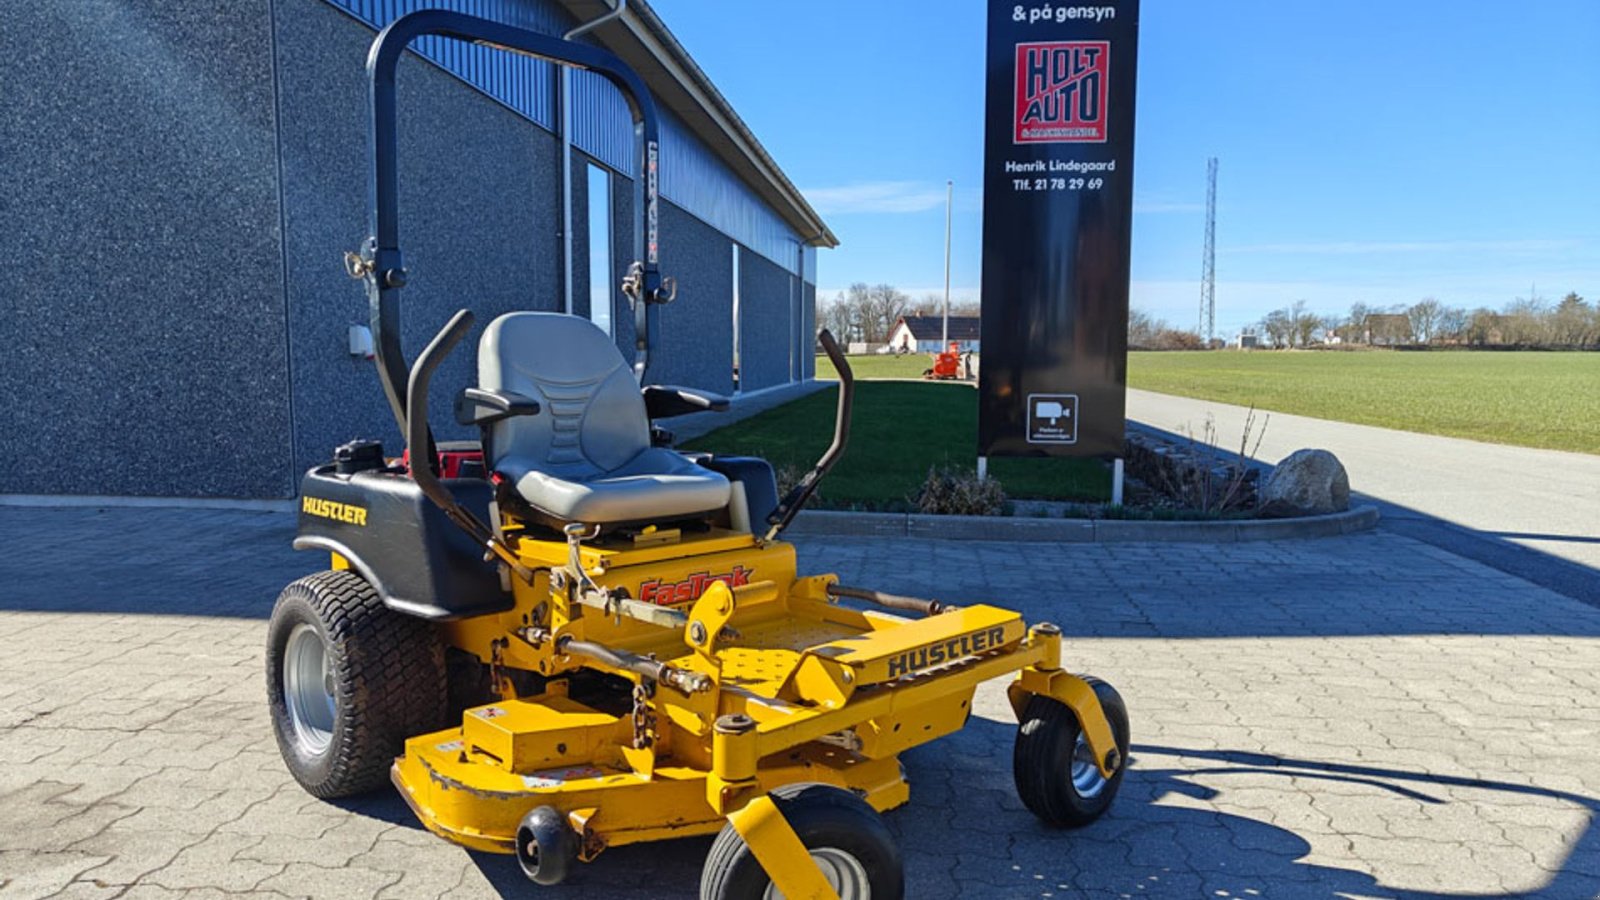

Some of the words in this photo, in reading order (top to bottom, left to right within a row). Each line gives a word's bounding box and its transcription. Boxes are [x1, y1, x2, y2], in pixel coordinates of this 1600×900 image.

[1012, 5, 1026, 21] &
[1030, 3, 1052, 24] på
[1056, 6, 1115, 22] gensyn
[1026, 48, 1102, 101] HOLT
[1022, 70, 1101, 124] AUTO
[1005, 160, 1046, 173] Henrik
[1049, 159, 1116, 174] Lindegaard
[1013, 179, 1032, 191] Tlf.
[1034, 179, 1047, 191] 21
[1050, 178, 1066, 190] 78
[1069, 178, 1084, 190] 29
[1087, 178, 1103, 190] 69
[303, 496, 367, 526] HUSTLER
[888, 626, 1004, 678] HUSTLER
